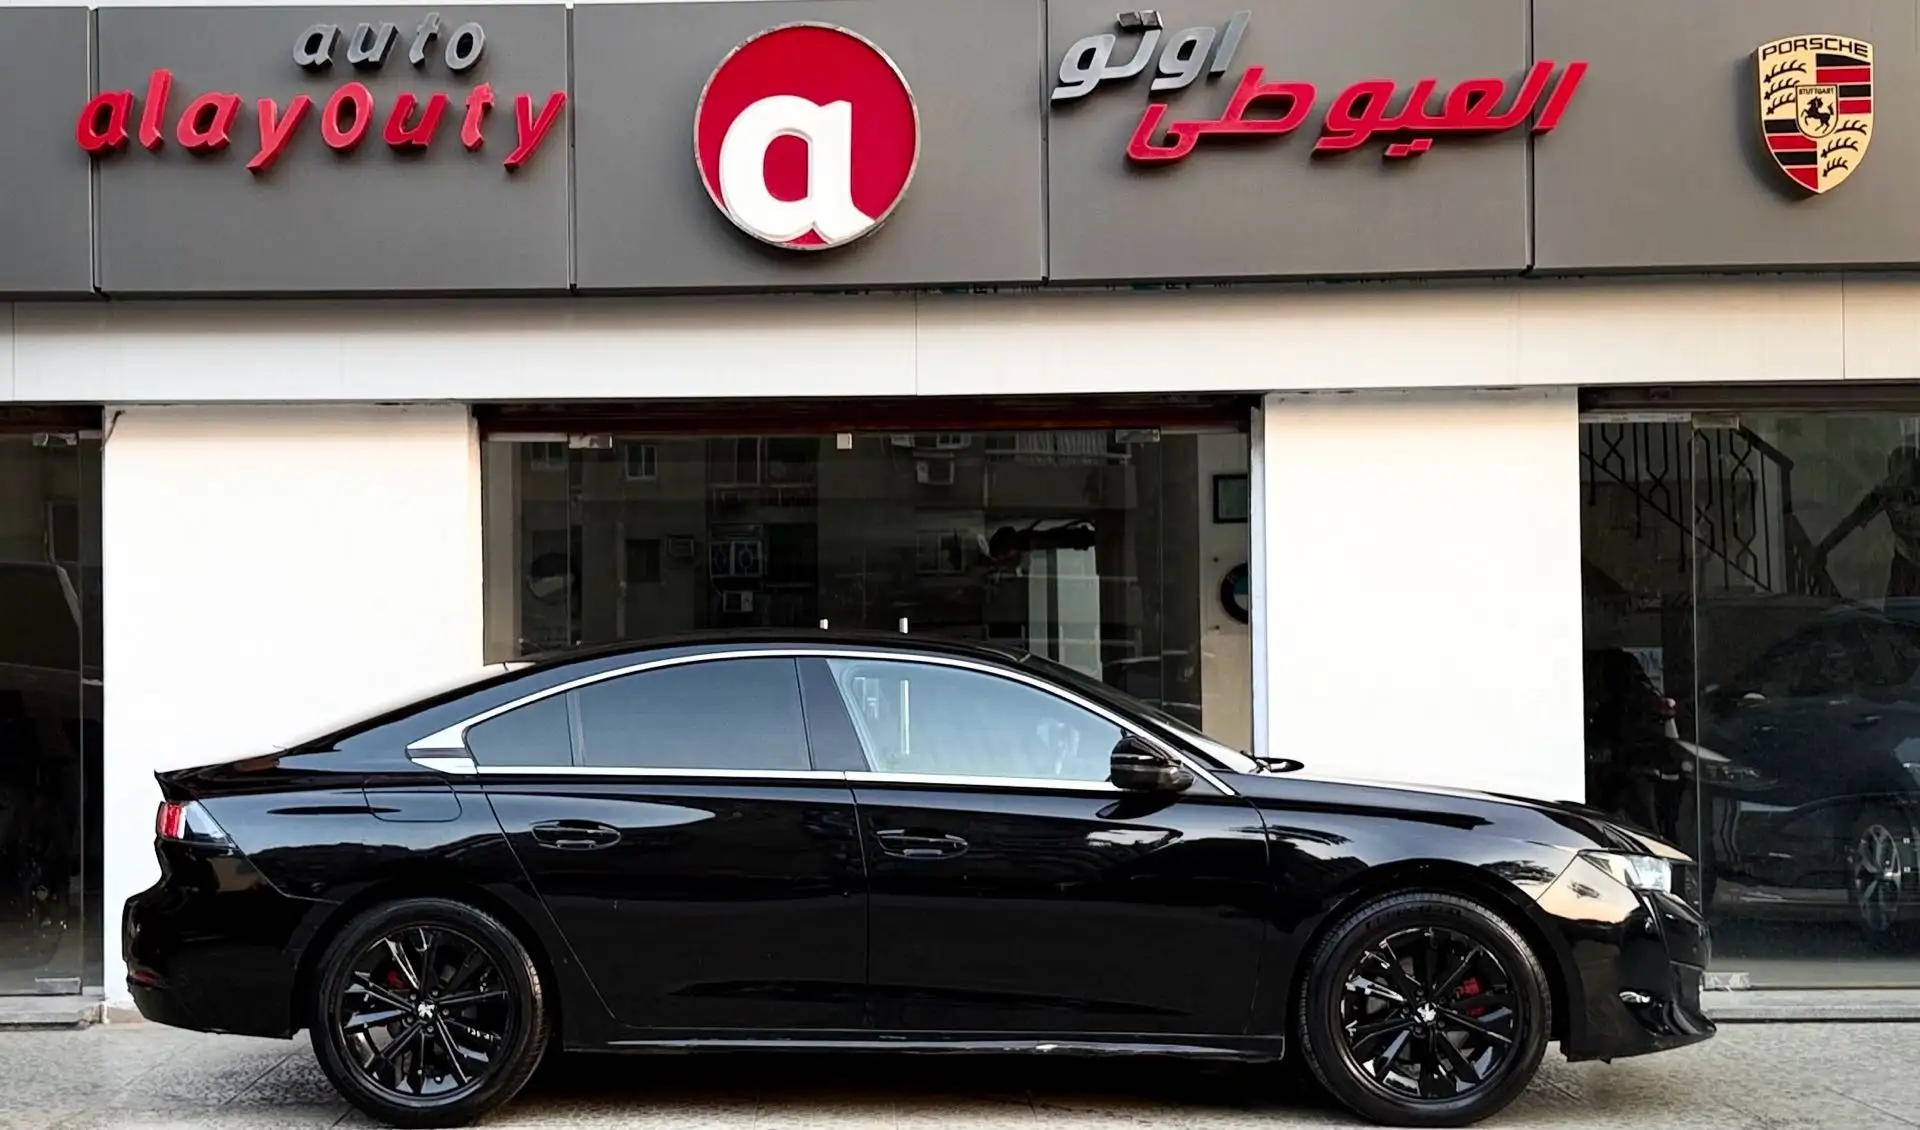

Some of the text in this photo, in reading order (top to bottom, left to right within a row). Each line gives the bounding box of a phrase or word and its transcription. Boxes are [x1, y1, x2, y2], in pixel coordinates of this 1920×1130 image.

[293, 12, 487, 71] auto
[1051, 10, 1252, 100] اوتو
[1762, 37, 1868, 61] PORSCHE
[719, 94, 875, 244] a
